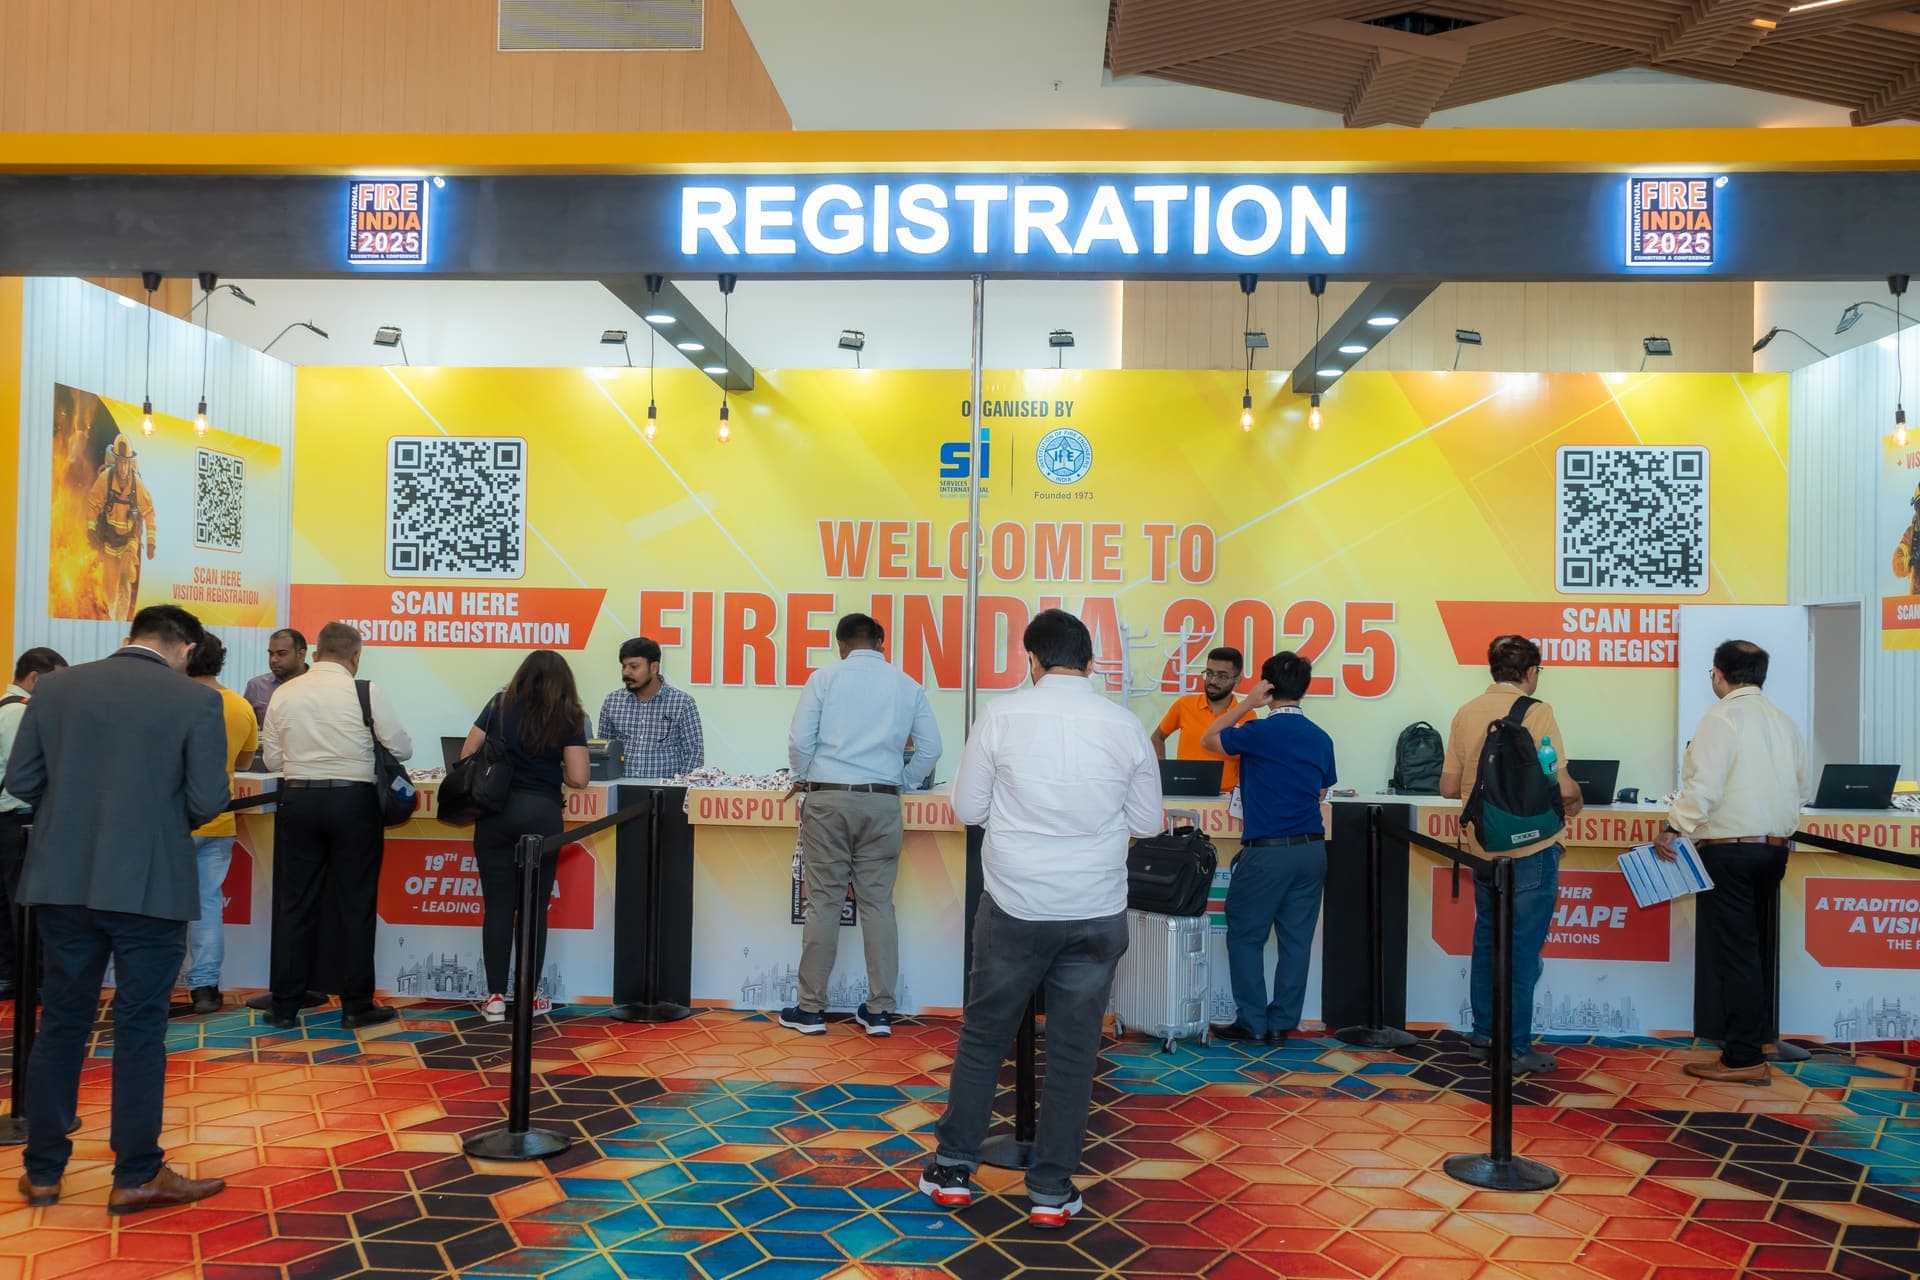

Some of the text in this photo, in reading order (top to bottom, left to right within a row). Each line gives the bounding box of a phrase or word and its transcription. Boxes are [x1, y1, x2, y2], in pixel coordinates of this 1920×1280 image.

[358, 183, 418, 211] FIRE
[1642, 181, 1707, 210] FIRE
[350, 184, 358, 250] INTERNATIONAL
[358, 212, 421, 230] INDIA
[681, 183, 1347, 256] REGISTRATION
[1633, 182, 1641, 251] INTERNATIONAL
[1642, 211, 1712, 230] INDIA
[359, 232, 419, 253] 2025
[1643, 232, 1710, 254] 2025
[961, 400, 1074, 418] OGANISED BY
[1034, 491, 1094, 500] Founded 1973
[817, 519, 1216, 585] WELCOME TO
[194, 567, 242, 587] SCAN HERE
[172, 583, 259, 605] VISITOR REGISTRATION
[391, 591, 519, 617] SCAN HERE
[1562, 607, 1630, 633] SCAN
[340, 619, 570, 646] SITOR REGISTRATION
[640, 591, 1398, 700] FIRE INDA 2025
[1599, 639, 1680, 662] REGIST
[700, 796, 785, 820] ONSPOT
[405, 876, 438, 896] OF
[421, 900, 480, 913] LEADING
[1815, 896, 1920, 913] A TRADITIO
[1848, 916, 1920, 934] A VISI
[1886, 939, 1912, 950] THE
